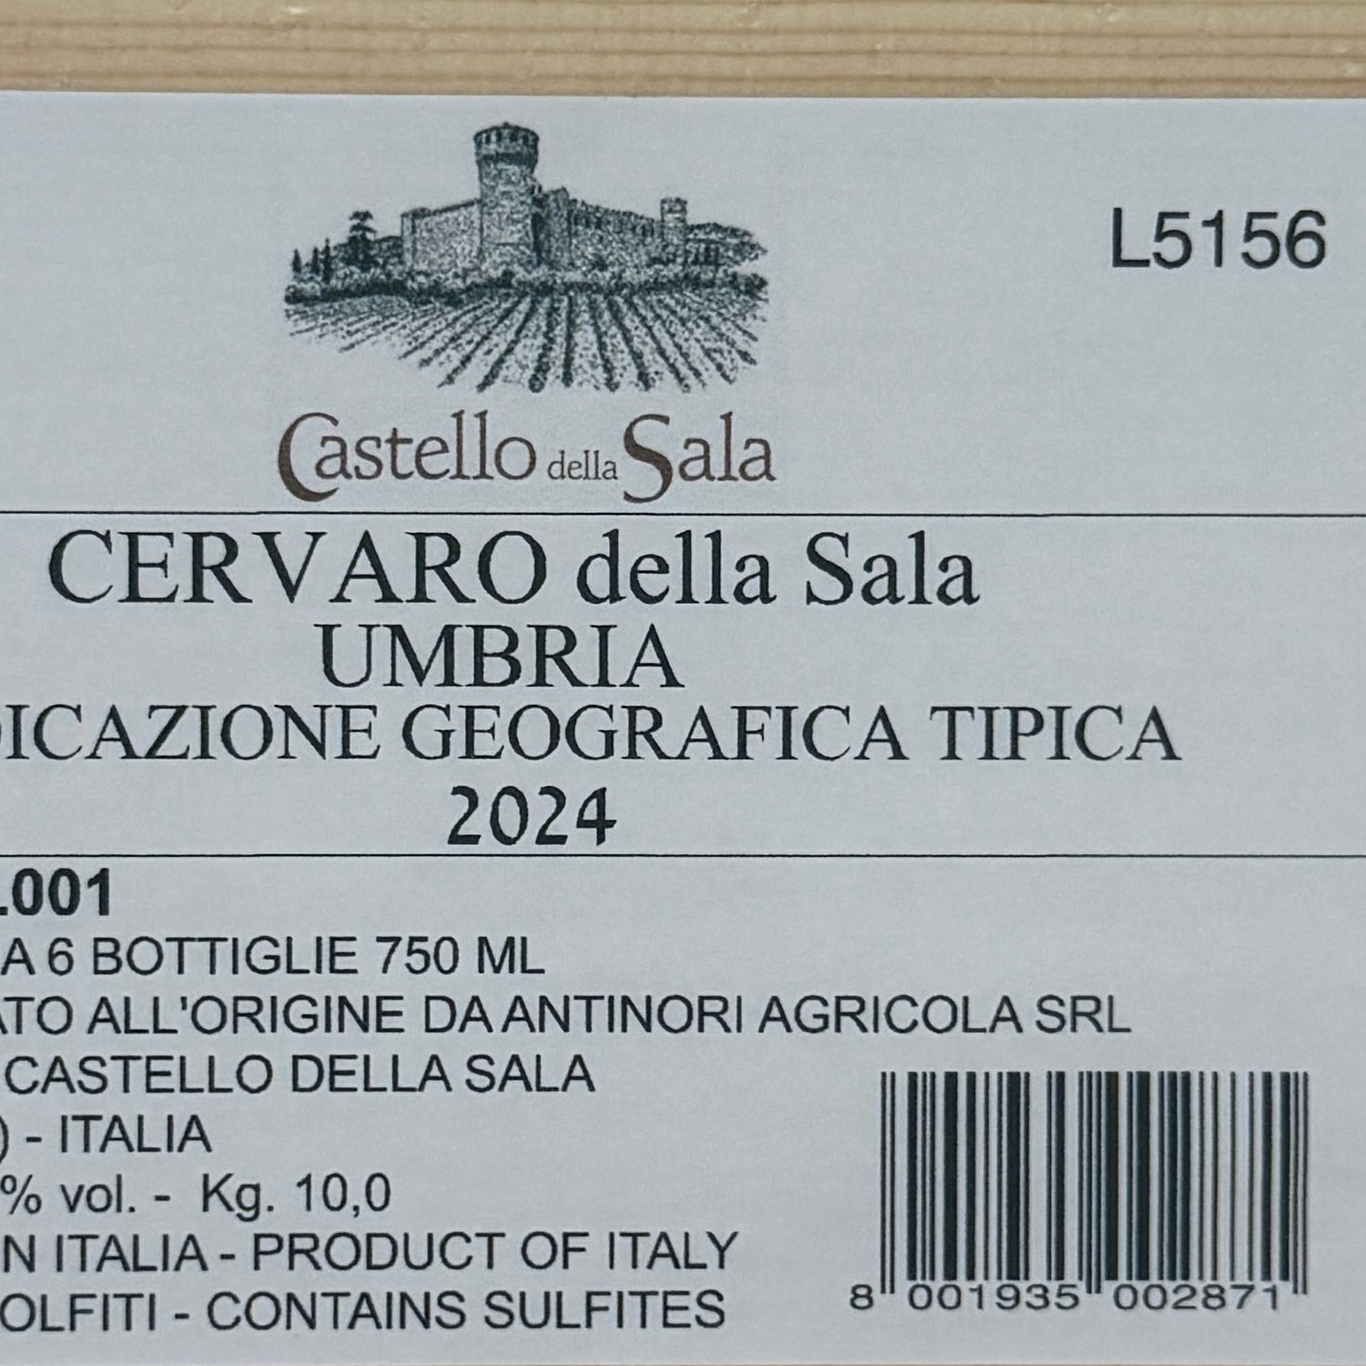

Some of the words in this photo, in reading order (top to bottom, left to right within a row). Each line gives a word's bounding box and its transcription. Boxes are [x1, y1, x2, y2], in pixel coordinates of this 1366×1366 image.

[1112, 207, 1326, 270] L5156
[277, 409, 537, 503] Castello
[547, 450, 619, 482] della
[622, 409, 777, 504] Sala
[47, 528, 547, 605] CERVARO
[576, 528, 777, 606] della
[805, 529, 981, 606] Sala
[313, 622, 686, 689] UMBRIA
[401, 703, 910, 762] GEOGRAFICA
[929, 704, 1183, 762] TIPICA
[446, 785, 618, 847] 2024
[47, 936, 75, 977] 6
[92, 935, 359, 977] BOTTIGLIE
[375, 935, 460, 976] 750
[477, 935, 546, 975] ML
[86, 993, 406, 1036] ALL'ORIGINE
[757, 994, 1024, 1035] AGRICOLA
[1035, 993, 1132, 1034] SRL
[4, 1053, 274, 1095] CASTELLO
[291, 1053, 453, 1094] DELLA
[465, 1053, 596, 1094] SALA
[60, 1113, 213, 1154] ITALIA
[59, 1173, 136, 1214] vol.
[201, 1172, 275, 1223] Kg.
[295, 1172, 392, 1219] 10,0
[55, 1233, 209, 1273] ITALIA
[253, 1231, 507, 1272] PRODUCT
[520, 1230, 590, 1271] OF
[608, 1231, 739, 1271] ITALY
[206, 1290, 467, 1331] CONTAINS
[483, 1288, 726, 1330] SULFITES
[849, 1283, 874, 1311] 8
[907, 1283, 1081, 1312] 001935
[1112, 1283, 1281, 1312] 002871
